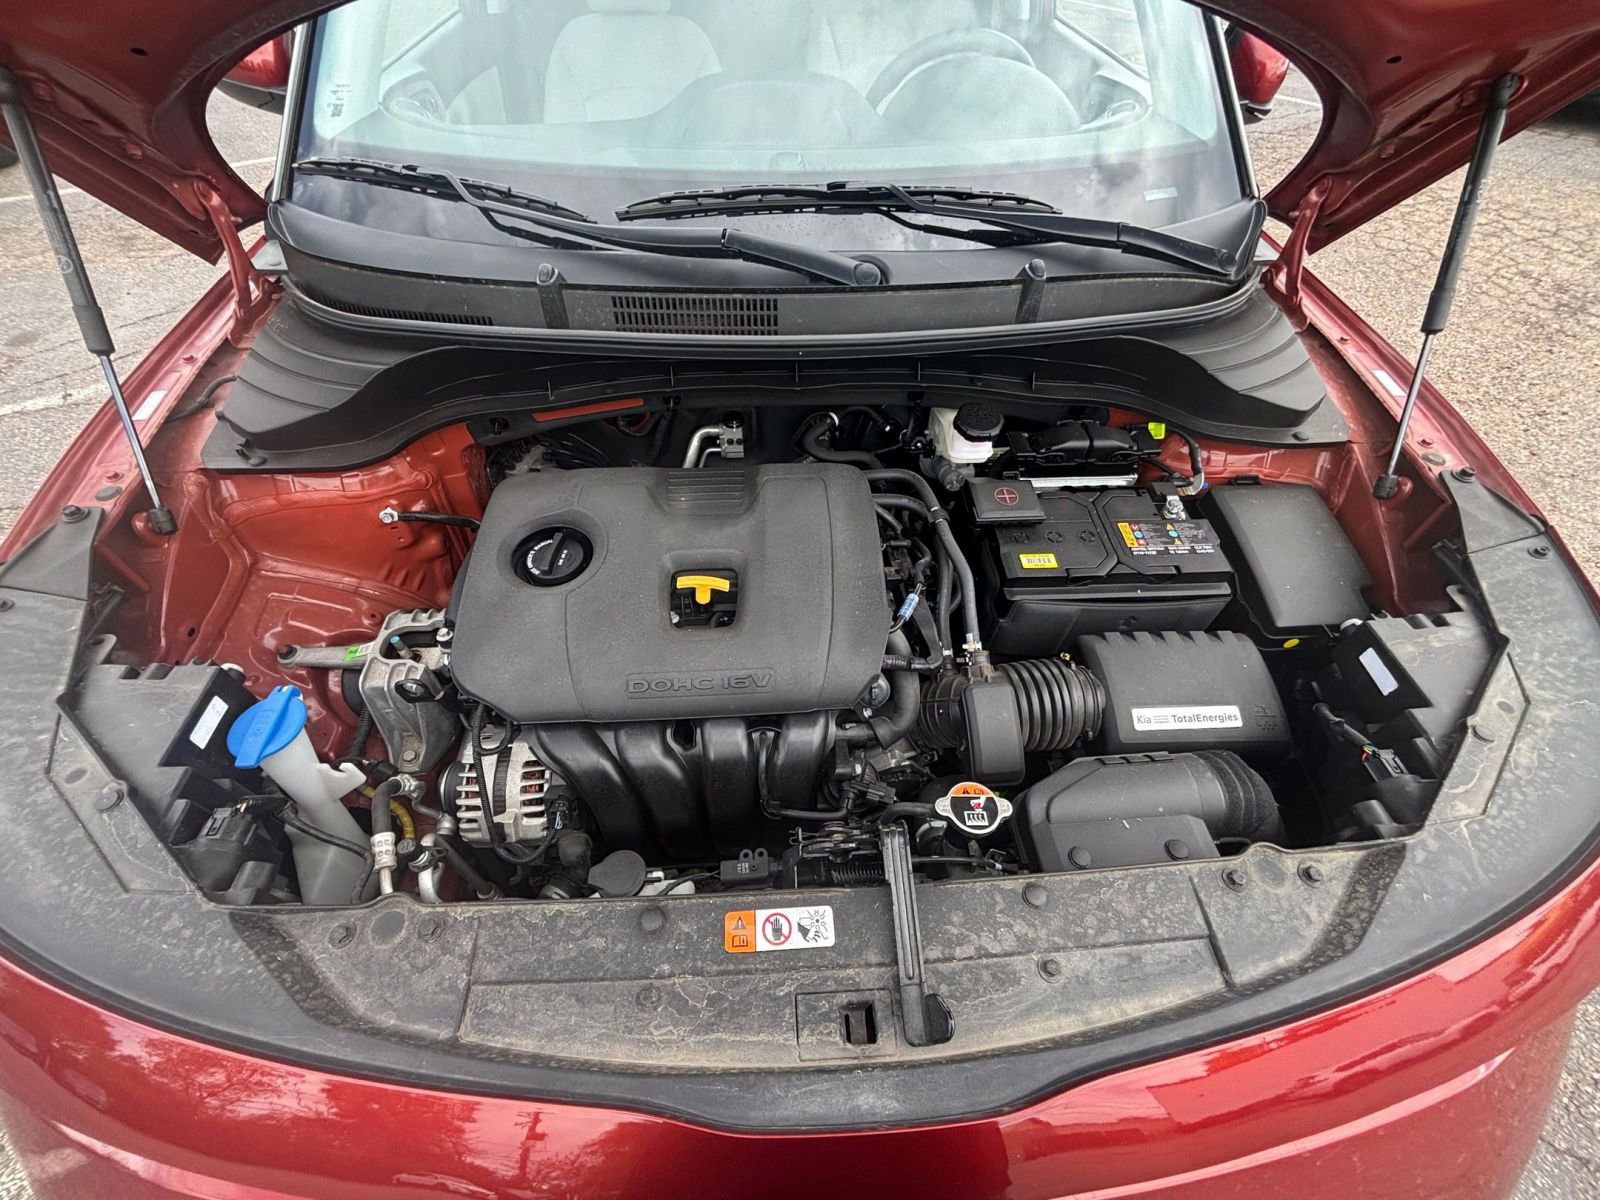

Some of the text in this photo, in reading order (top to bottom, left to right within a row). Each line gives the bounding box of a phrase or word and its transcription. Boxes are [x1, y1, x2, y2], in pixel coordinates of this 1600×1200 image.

[628, 673, 773, 694] DOHC 16V
[1136, 712, 1239, 725] Kia TotalEnergies
